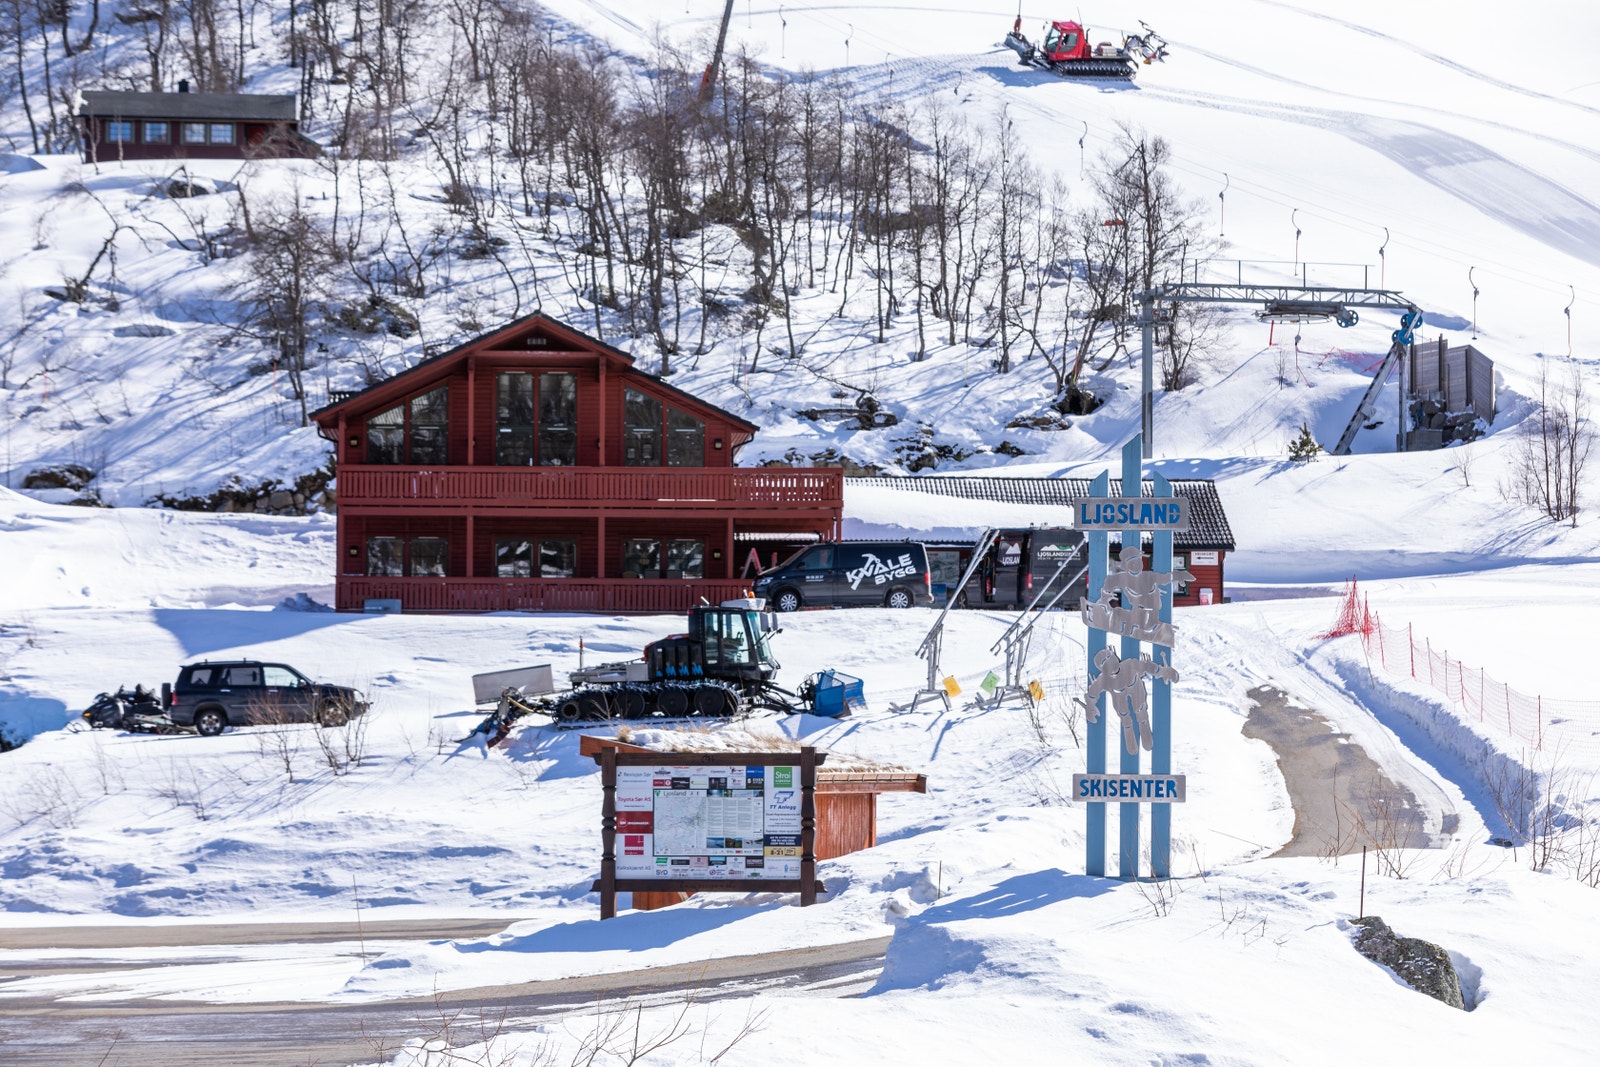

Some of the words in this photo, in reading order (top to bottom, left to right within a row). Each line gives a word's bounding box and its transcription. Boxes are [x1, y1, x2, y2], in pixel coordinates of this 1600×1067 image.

[1081, 503, 1181, 525] LJOSLAND
[845, 553, 914, 587] KVALE
[874, 565, 917, 585] BYGG
[1080, 779, 1178, 798] SKISENTER
